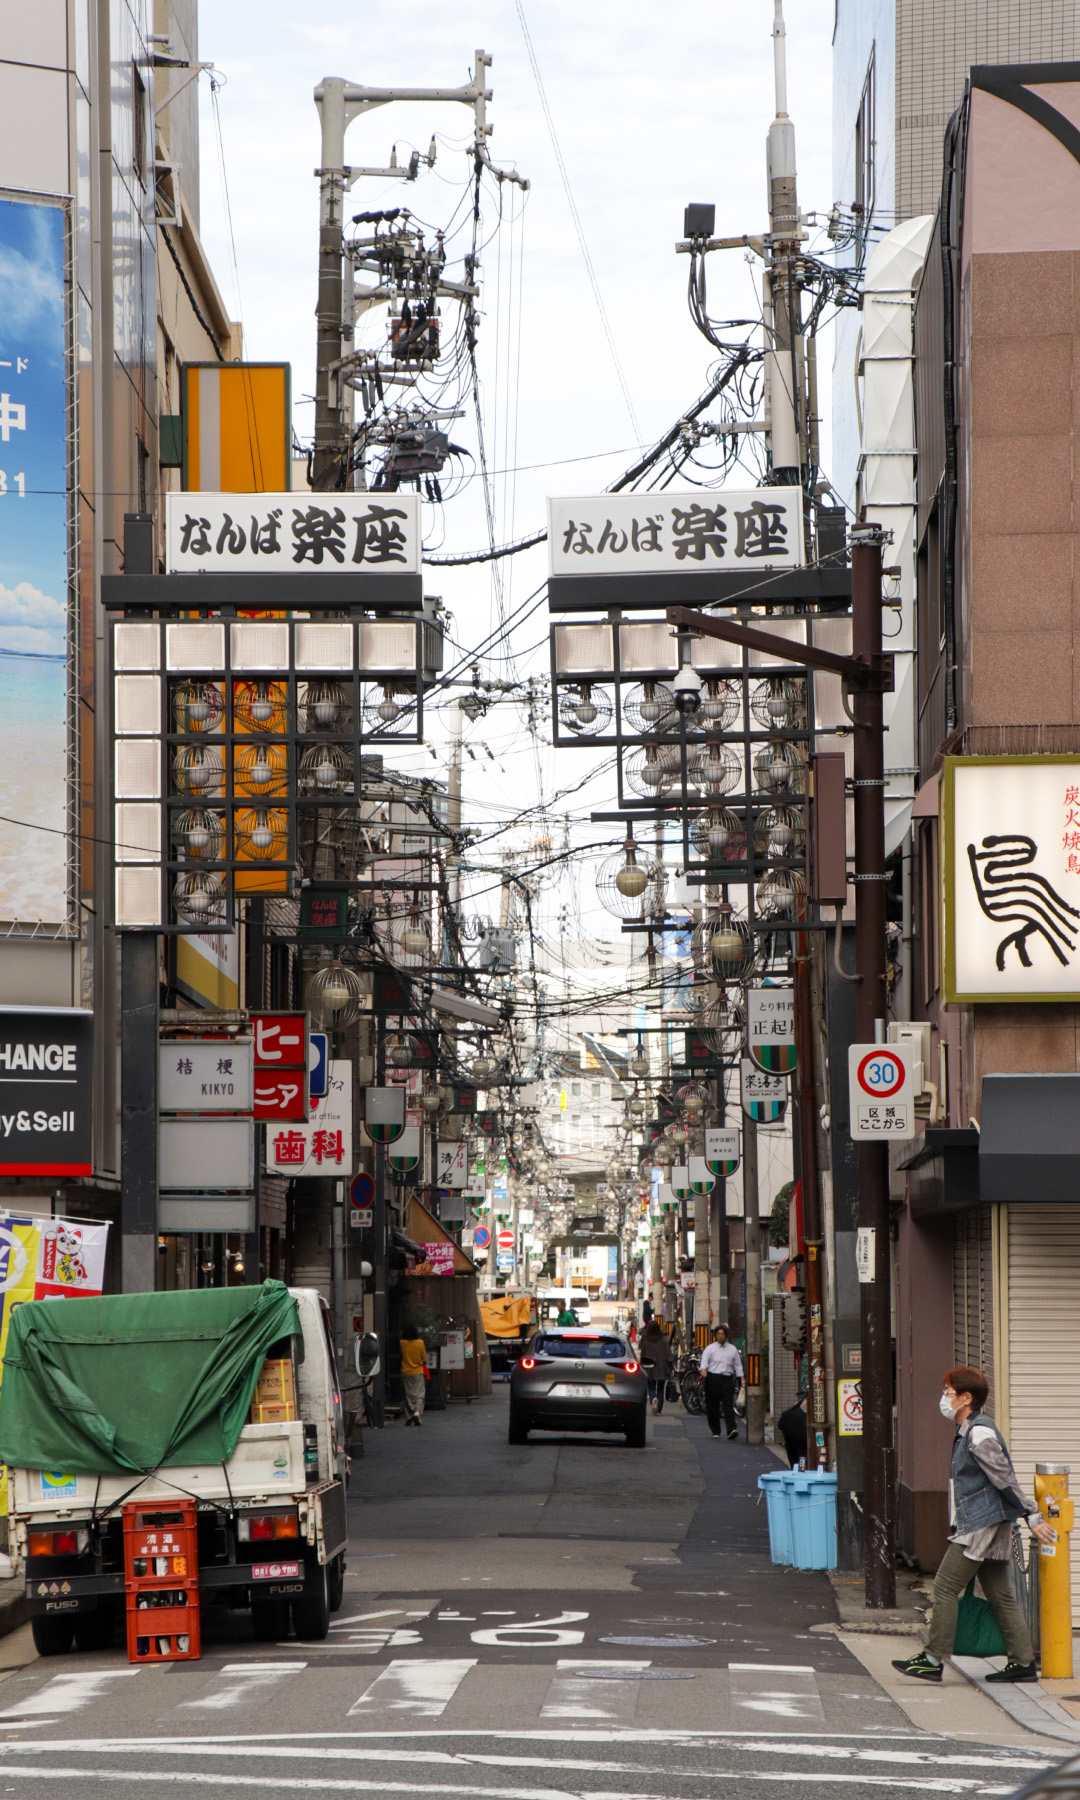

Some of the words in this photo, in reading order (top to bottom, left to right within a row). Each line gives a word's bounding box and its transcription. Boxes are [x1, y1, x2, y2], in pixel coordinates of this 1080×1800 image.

[180, 504, 409, 565] なんば楽座
[562, 500, 790, 562] なんば楽座
[1061, 784, 1080, 875] 炭火焼鳥
[401, 836, 426, 844] shinoda
[0, 1043, 77, 1072] HANGE
[869, 1063, 894, 1084] 30
[201, 1083, 235, 1096] KIKYO
[319, 1111, 341, 1121] office
[869, 1107, 896, 1118] 区域
[860, 1118, 906, 1130] ここから
[273, 1129, 346, 1165] 歯科
[457, 1144, 465, 1168] グリル
[352, 1211, 371, 1220] 自動車
[147, 1533, 174, 1545] 清酒
[270, 1583, 303, 1594] FUSO
[46, 1599, 79, 1611] FUSO
